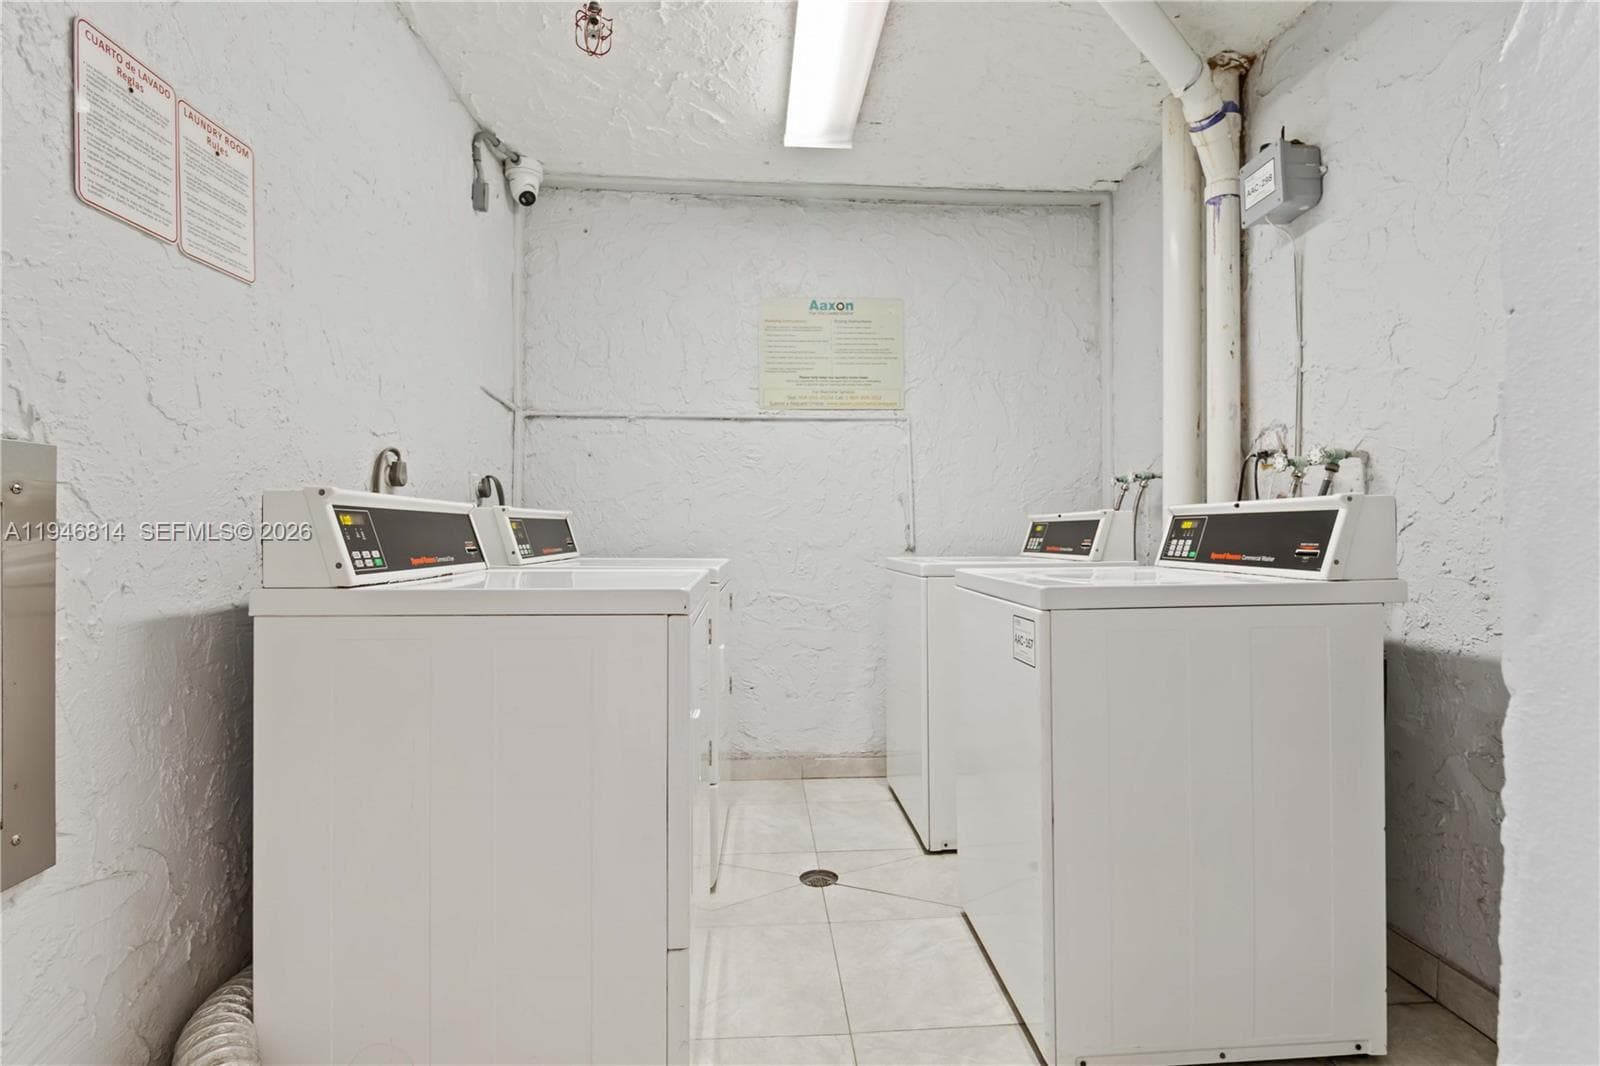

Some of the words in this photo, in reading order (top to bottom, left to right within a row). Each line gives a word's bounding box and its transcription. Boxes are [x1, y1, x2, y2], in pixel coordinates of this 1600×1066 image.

[84, 29, 124, 64] CUARTO
[125, 59, 137, 74] de
[138, 68, 172, 100] LAVADO
[116, 66, 145, 94] Reglas
[183, 107, 223, 141] LAUNDRY
[224, 136, 250, 160] ROOM
[206, 136, 229, 158] Rules
[809, 299, 854, 311] Aaxon
